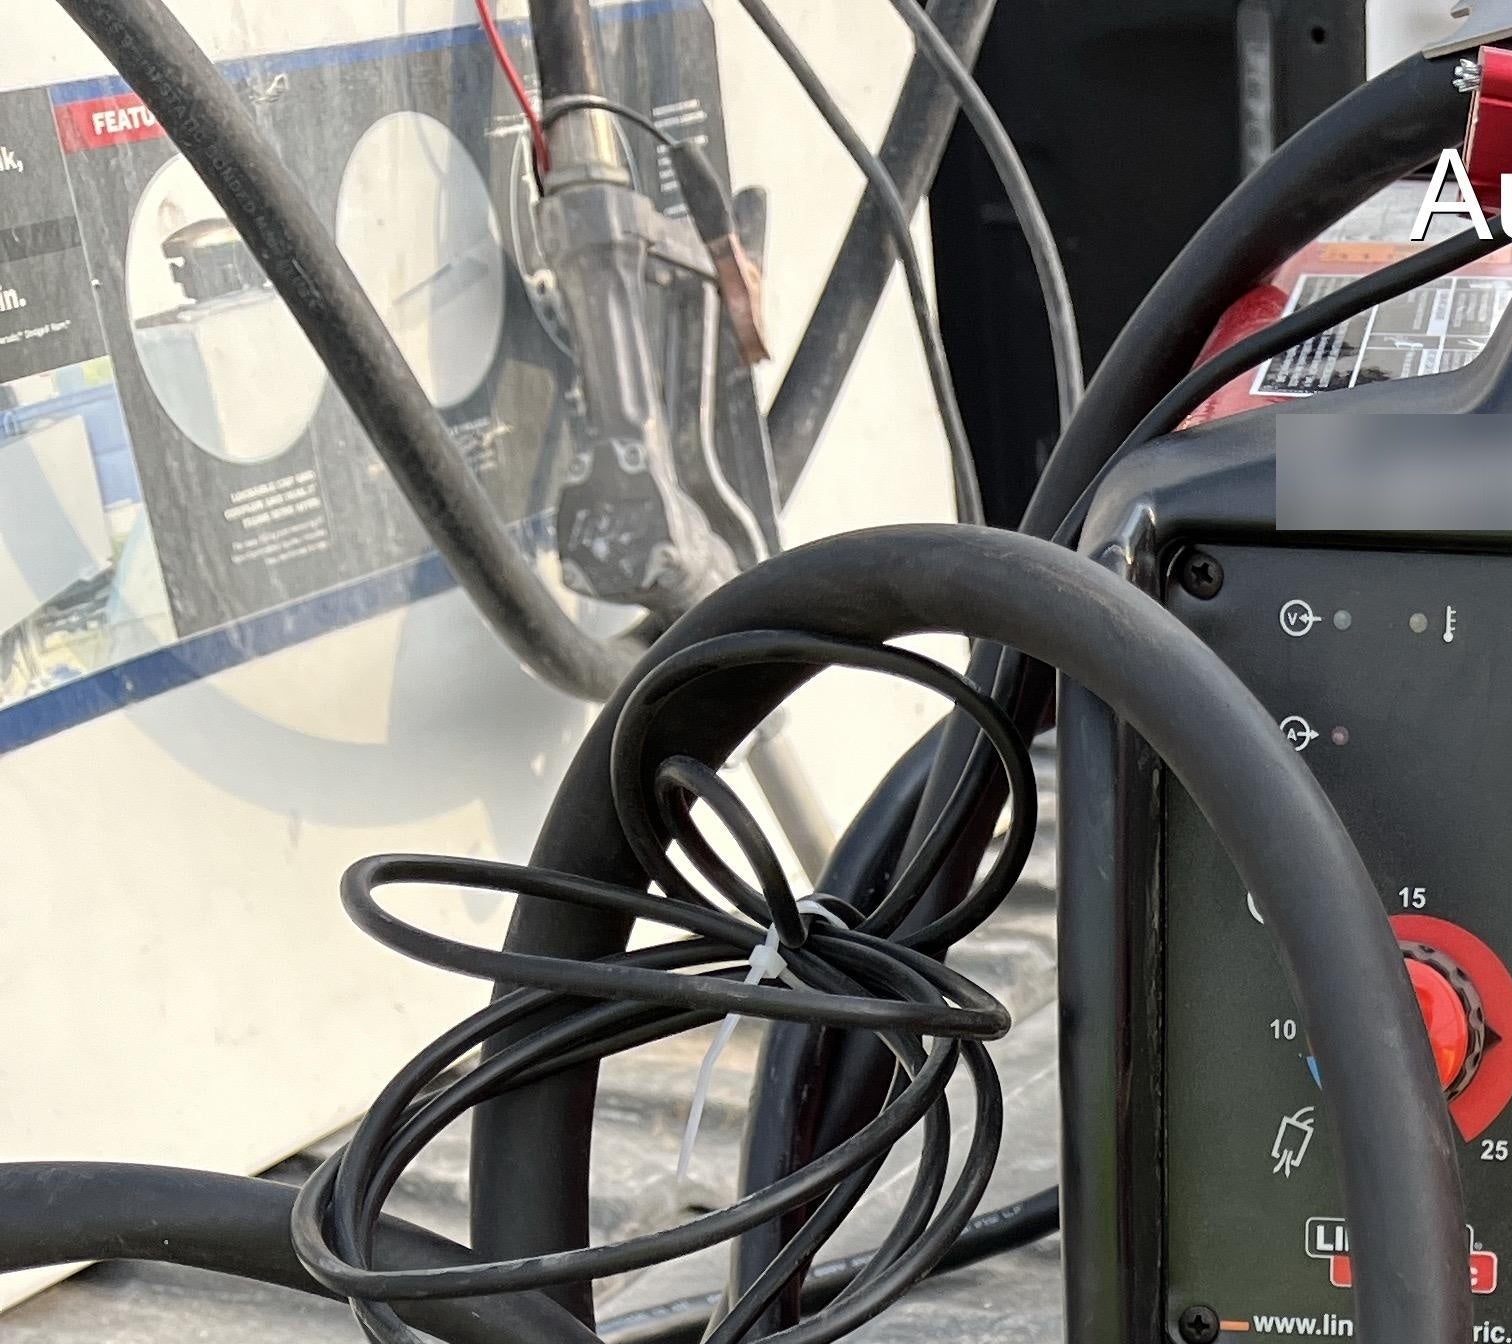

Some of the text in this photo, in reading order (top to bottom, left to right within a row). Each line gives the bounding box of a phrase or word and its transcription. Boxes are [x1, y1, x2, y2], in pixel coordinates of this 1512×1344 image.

[92, 104, 157, 136] FEATU
[1398, 887, 1427, 909] 15
[1270, 1018, 1297, 1041] 10
[1480, 1139, 1509, 1161] 25
